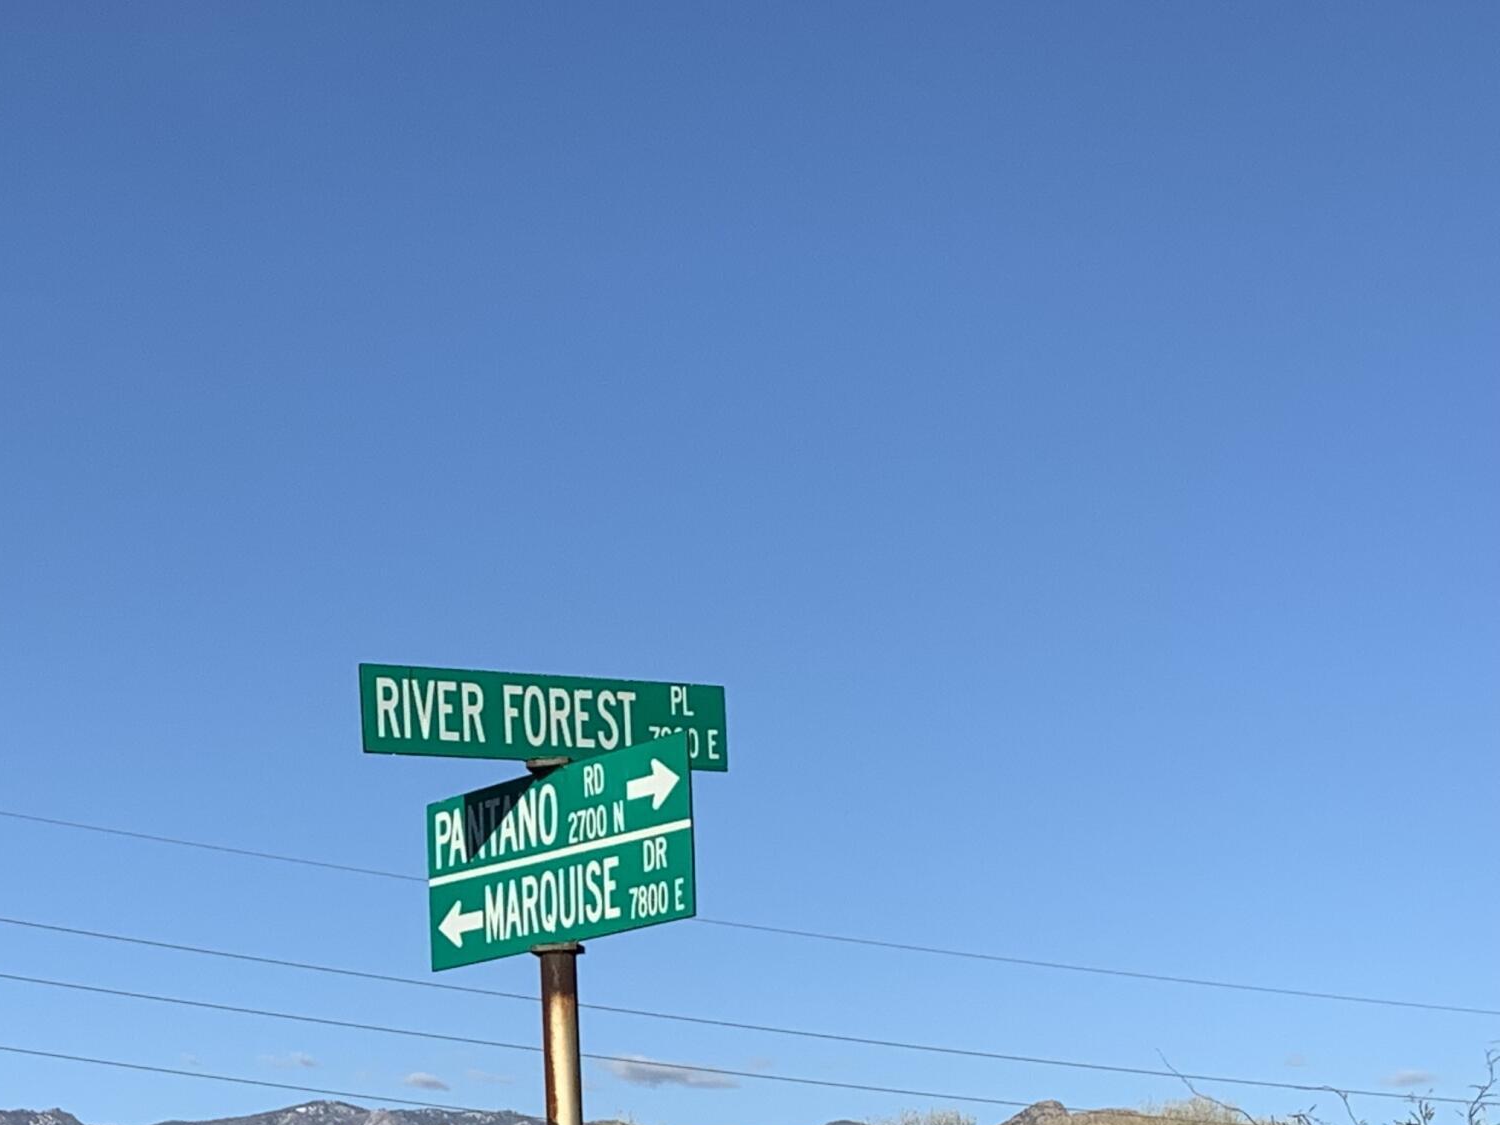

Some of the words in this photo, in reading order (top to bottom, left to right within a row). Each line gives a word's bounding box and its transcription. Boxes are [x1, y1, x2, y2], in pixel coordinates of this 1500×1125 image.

[375, 676, 486, 743] RIVER
[502, 684, 637, 751] FOREST
[670, 685, 694, 717] PL
[648, 725, 699, 759] 70
[707, 728, 720, 760] E
[434, 783, 558, 870] PANTANO
[583, 763, 605, 798] RD
[567, 804, 607, 844] 2700
[613, 800, 625, 832] N
[484, 856, 621, 943] MARQUISE
[643, 837, 668, 873] DR
[628, 885, 669, 920] 7800
[674, 878, 685, 911] E
